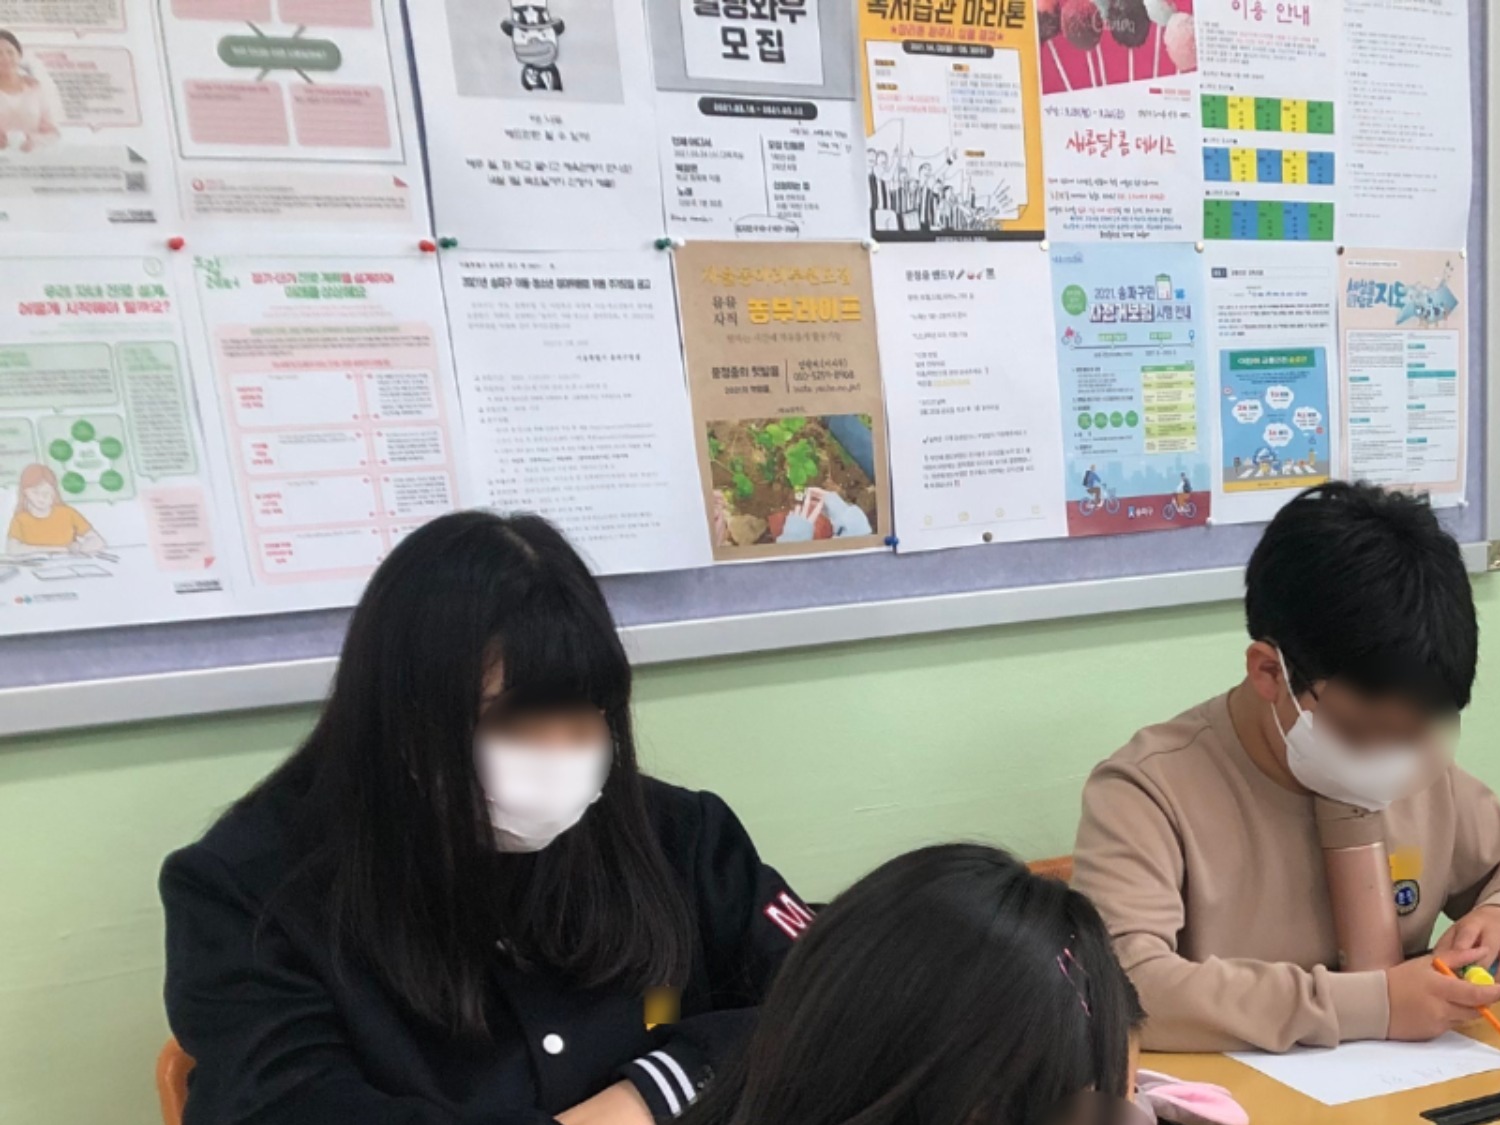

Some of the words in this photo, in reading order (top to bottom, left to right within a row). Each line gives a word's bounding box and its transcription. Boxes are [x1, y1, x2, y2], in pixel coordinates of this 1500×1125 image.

[962, 0, 1026, 29] 마라톤
[1231, 0, 1268, 21] 이용
[1276, 1, 1311, 26] 안내
[720, 26, 786, 64] 모집
[1118, 285, 1155, 301] 송파구민
[1175, 304, 1192, 320] 안내
